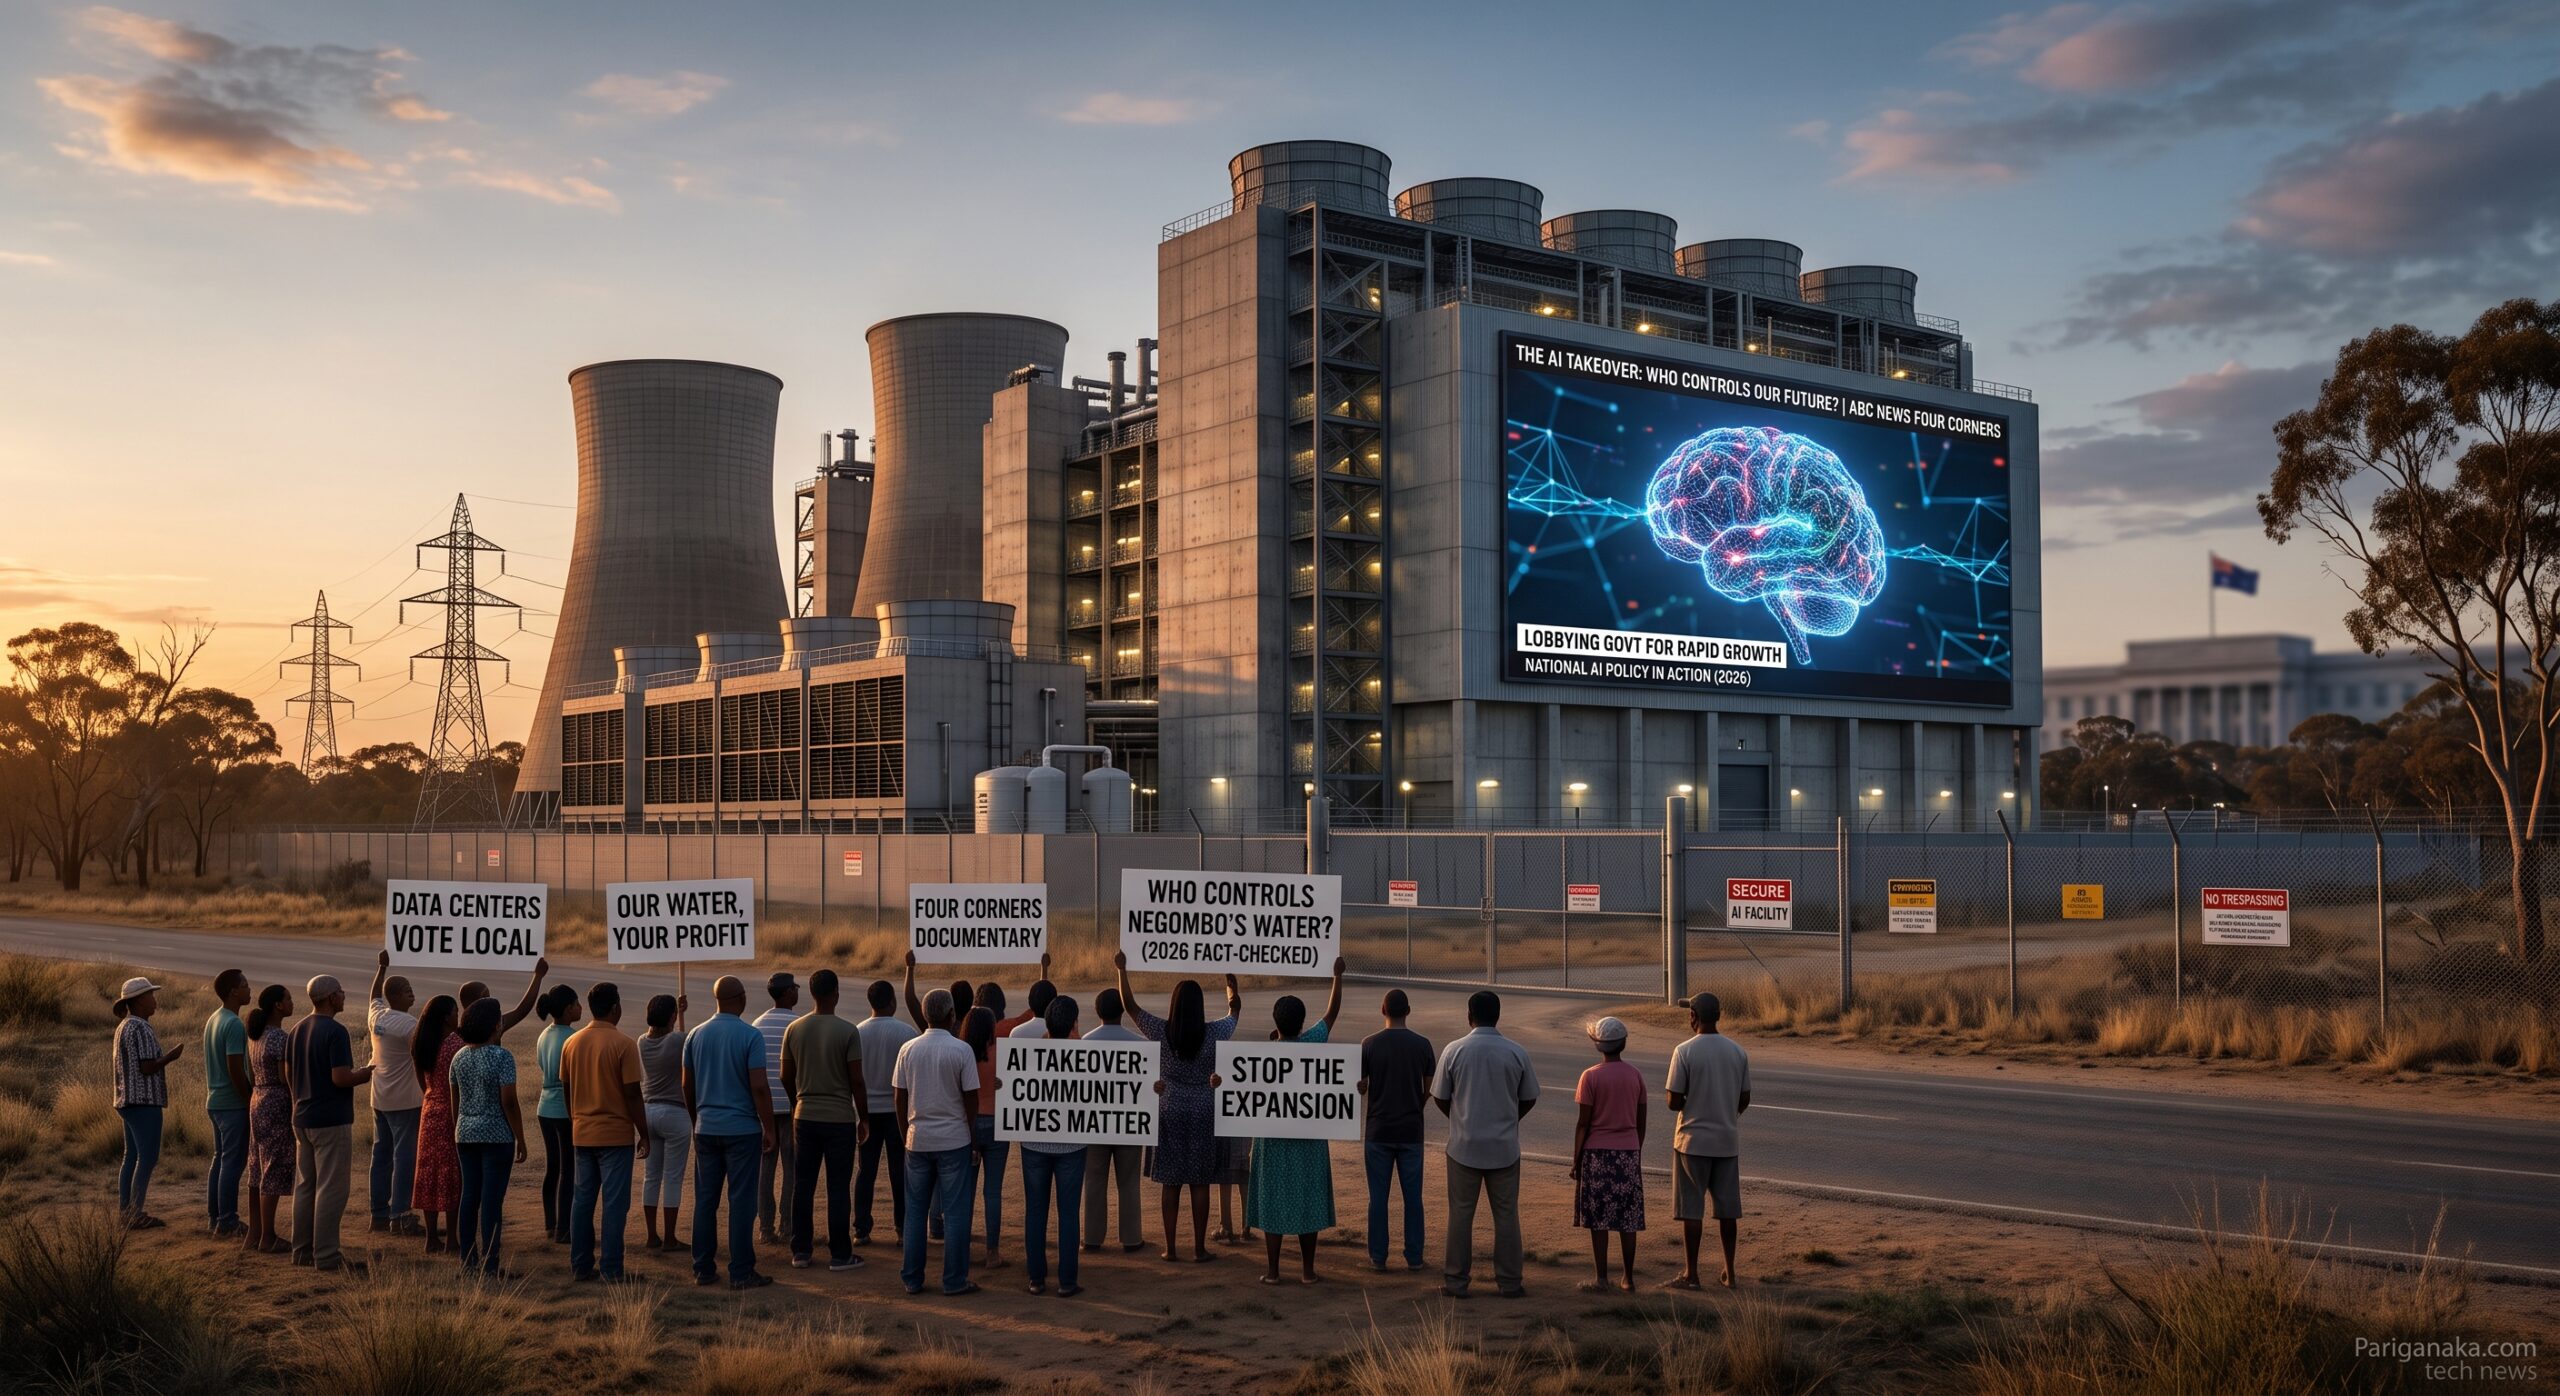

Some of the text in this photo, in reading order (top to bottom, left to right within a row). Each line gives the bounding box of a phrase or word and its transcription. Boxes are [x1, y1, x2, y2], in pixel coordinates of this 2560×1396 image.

[1516, 344, 1544, 365] THE
[1548, 350, 1562, 367] AI
[1566, 352, 1642, 380] TAKEOVER:
[1646, 366, 1678, 386] WHO
[1682, 372, 1751, 398] CONTROLS
[1754, 384, 1781, 402] OUR
[1784, 389, 1839, 412] FUTURE?
[1849, 400, 1874, 418] ABC
[1877, 405, 1911, 424] NEWS
[1914, 410, 1945, 430] FOUR
[1948, 416, 2001, 439] CORNERS
[1524, 629, 1782, 663] LOBBYING GOVT FOR RAPID GROWTH
[1525, 657, 1588, 676] NATIONAL
[1590, 662, 1603, 676] AI
[1606, 662, 1649, 679] POLICY
[1652, 666, 1664, 680] IN
[1667, 667, 1712, 683] ACTION
[617, 891, 744, 919] OUR WATER,
[1148, 879, 1315, 908] WHO CONTROLS
[1732, 884, 1785, 898] SECURE
[2205, 893, 2284, 907] NO TRESPASSING
[392, 892, 541, 920] DATA CENTERS
[915, 898, 1043, 919] FOUR CORNERS
[1731, 906, 1788, 921] AI FACILITY
[613, 923, 749, 951] YOUR PROFIT
[915, 927, 1042, 948] DOCUMENTARY
[1128, 910, 1334, 939] NEGOMBO'S WATER?
[392, 924, 538, 956] VOTE LOCAL
[1142, 940, 1319, 968] (2026 FACT-CHECKED)
[1006, 1048, 1148, 1075] AI TAKEOVER:
[1232, 1056, 1345, 1085] STOP THE
[1012, 1077, 1142, 1105] COMMUNITY
[1222, 1090, 1354, 1120] EXPANSION
[1002, 1107, 1151, 1135] LIVES MATTER
